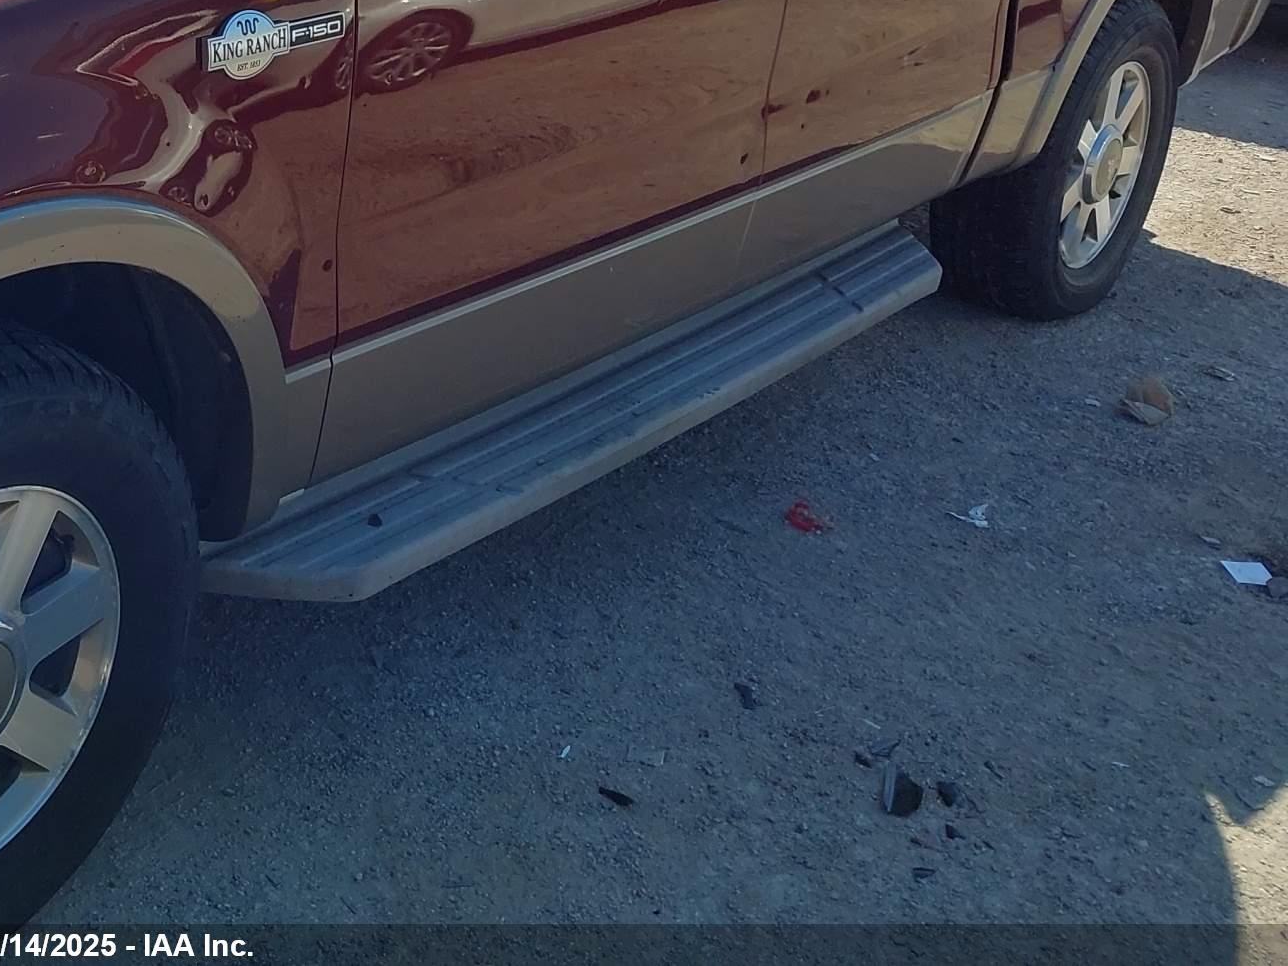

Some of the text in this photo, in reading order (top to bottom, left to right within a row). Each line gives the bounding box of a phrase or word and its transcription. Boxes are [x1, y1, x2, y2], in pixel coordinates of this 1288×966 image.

[292, 19, 341, 43] F-150
[213, 27, 288, 64] KING RANCH
[236, 63, 249, 73] EST.
